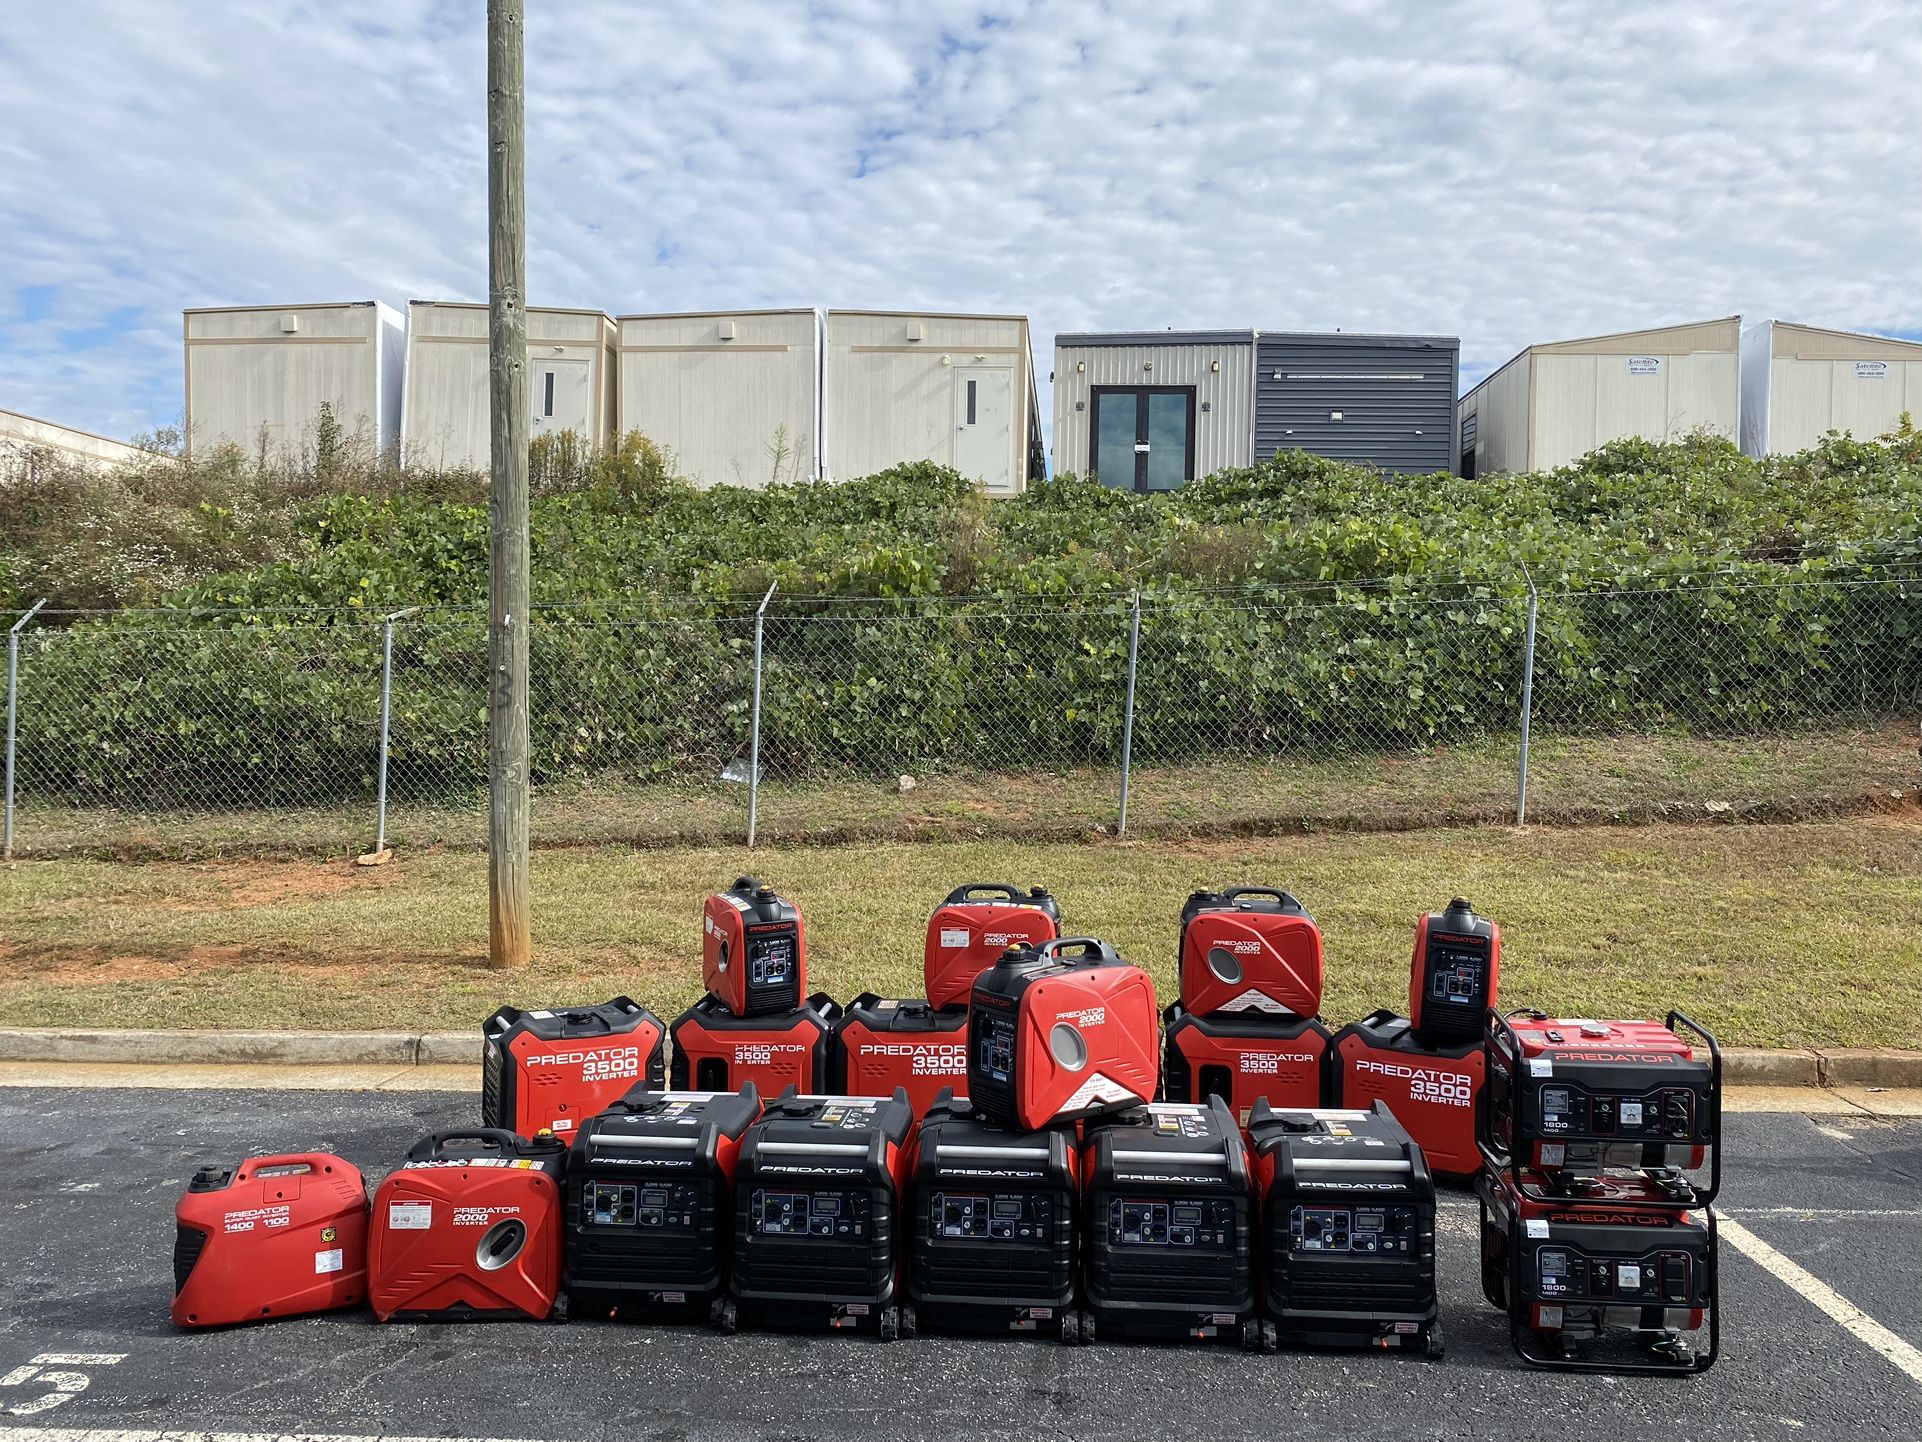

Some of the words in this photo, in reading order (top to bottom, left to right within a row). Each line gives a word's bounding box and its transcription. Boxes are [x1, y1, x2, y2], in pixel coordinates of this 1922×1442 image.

[750, 923, 793, 932] PREDATOR
[1433, 934, 1485, 945] PREDATOR
[1056, 1007, 1105, 1020] PREDATOR
[1078, 1014, 1105, 1023] 2000
[1078, 1020, 1105, 1028] INVERTER
[860, 1045, 967, 1055] PREDATOR
[527, 1046, 638, 1067] PREDATOR
[735, 1051, 771, 1060] 3500
[1240, 1052, 1314, 1062] PREDATOR
[1555, 1052, 1674, 1063] PREDATOR
[582, 1058, 638, 1075] 3500
[912, 1056, 967, 1068] 3500
[1240, 1060, 1278, 1068] 3500
[582, 1070, 638, 1082] INVERTER
[1356, 1060, 1471, 1087] PREDATOR
[1410, 1080, 1471, 1100] 3500
[1410, 1092, 1471, 1108] INVERTER
[590, 1158, 693, 1166] PREDATOR
[760, 1165, 864, 1174] PREDATOR
[939, 1168, 1044, 1177] PREDATOR
[1116, 1174, 1222, 1182] PREDATOR
[224, 1205, 290, 1219] PREDATOR
[453, 1206, 520, 1214] PREDATOR
[453, 1213, 489, 1221] 2000
[1551, 1213, 1669, 1225] PREDATOR
[224, 1221, 255, 1231] 1400
[262, 1216, 290, 1226] 1100
